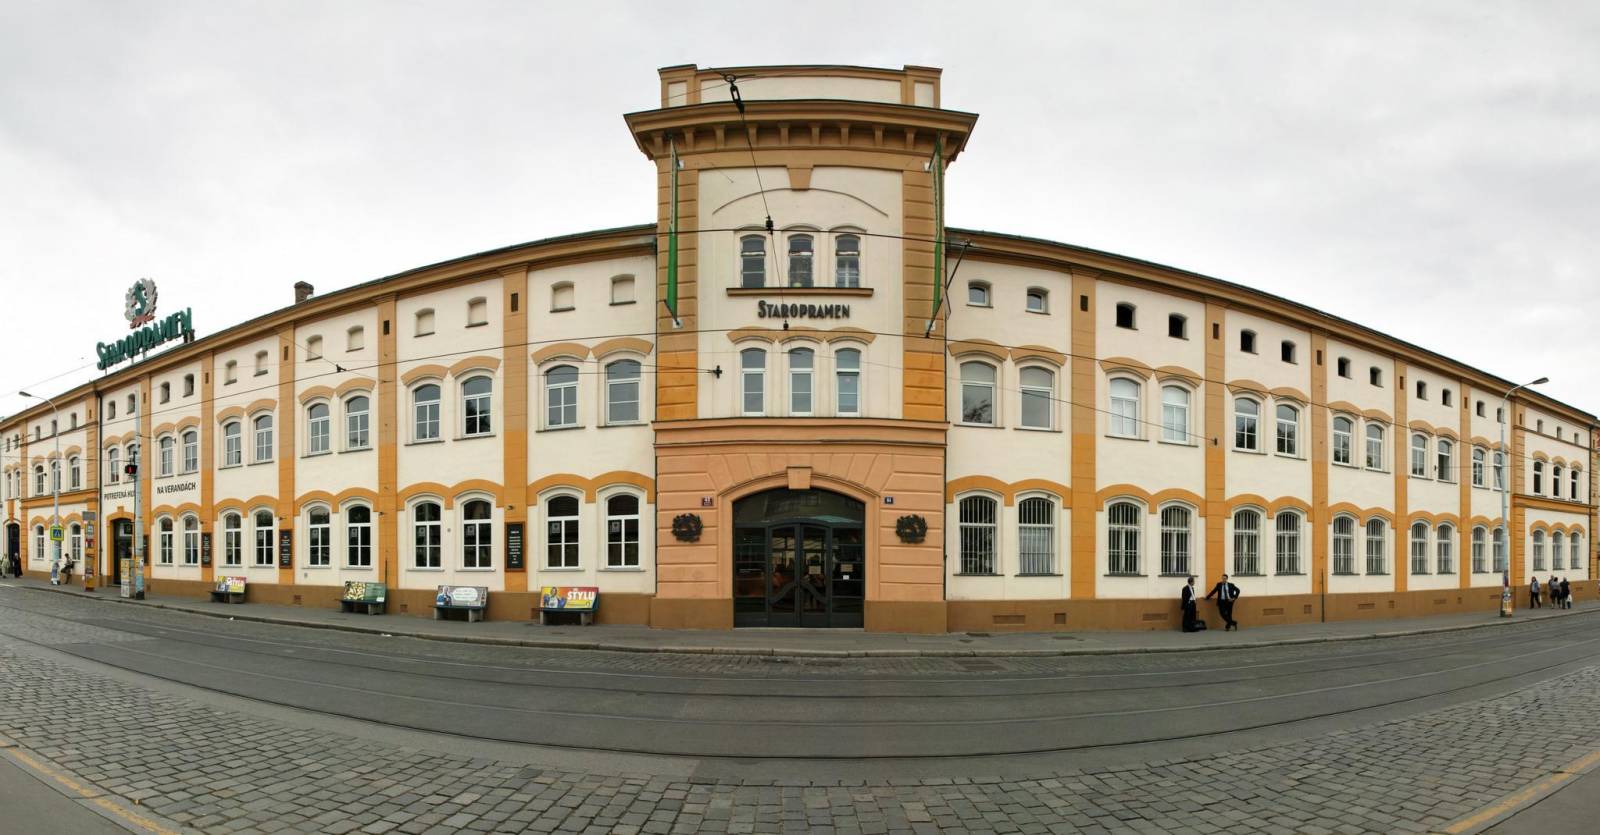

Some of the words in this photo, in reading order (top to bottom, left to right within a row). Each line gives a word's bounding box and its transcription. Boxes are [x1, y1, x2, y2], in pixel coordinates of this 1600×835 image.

[758, 300, 850, 319] STAROPRAMEN
[96, 307, 192, 370] STAROPRAMEN
[156, 486, 164, 494] NA
[164, 481, 197, 494] VERANDÁCH
[567, 591, 595, 600] STYLU
